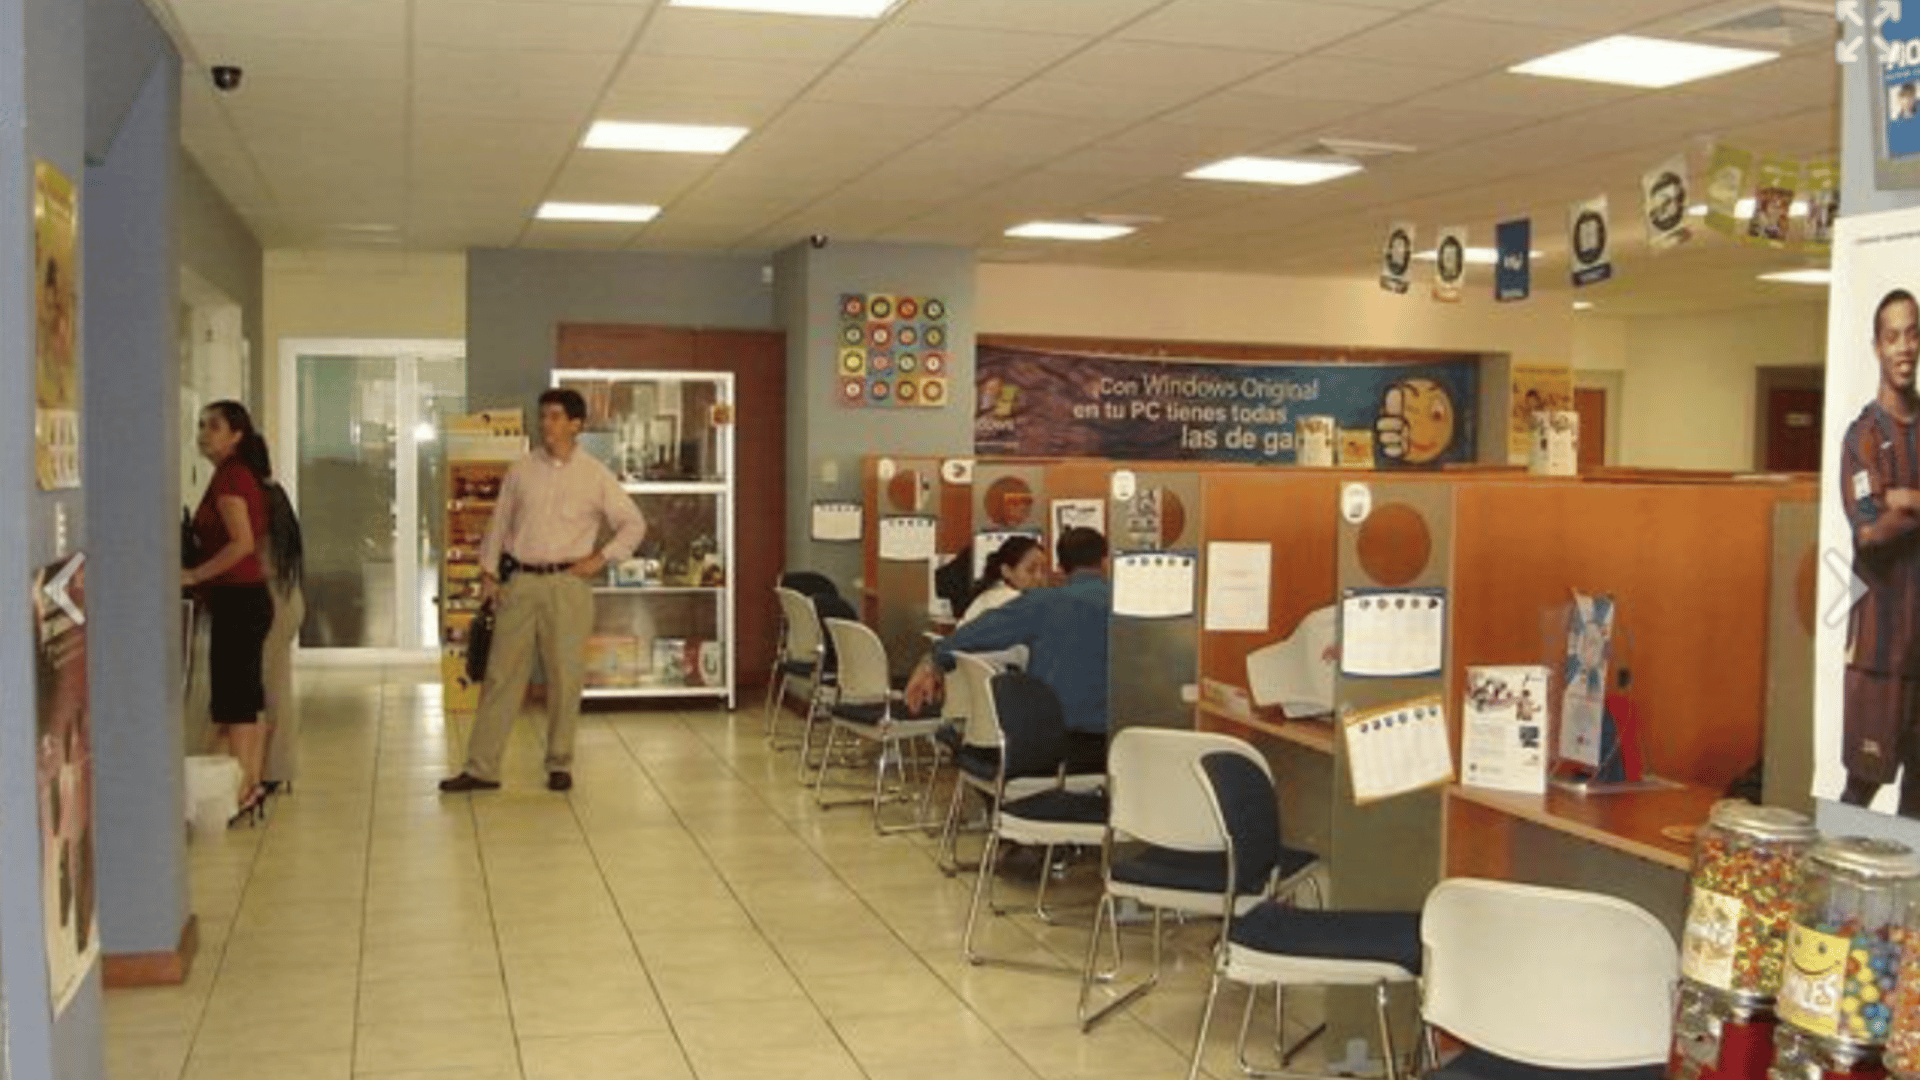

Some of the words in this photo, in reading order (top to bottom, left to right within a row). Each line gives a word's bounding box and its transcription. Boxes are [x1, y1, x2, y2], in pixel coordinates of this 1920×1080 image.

[1142, 373, 1239, 397] Windows
[1241, 377, 1319, 405] Original
[1073, 404, 1100, 419] en
[1104, 402, 1126, 419] tu
[1130, 401, 1160, 420] PC
[1166, 402, 1226, 422] tienes
[1231, 403, 1287, 424] todas
[1181, 424, 1217, 449] las
[1225, 425, 1257, 449] de
[1263, 431, 1295, 455] ga
